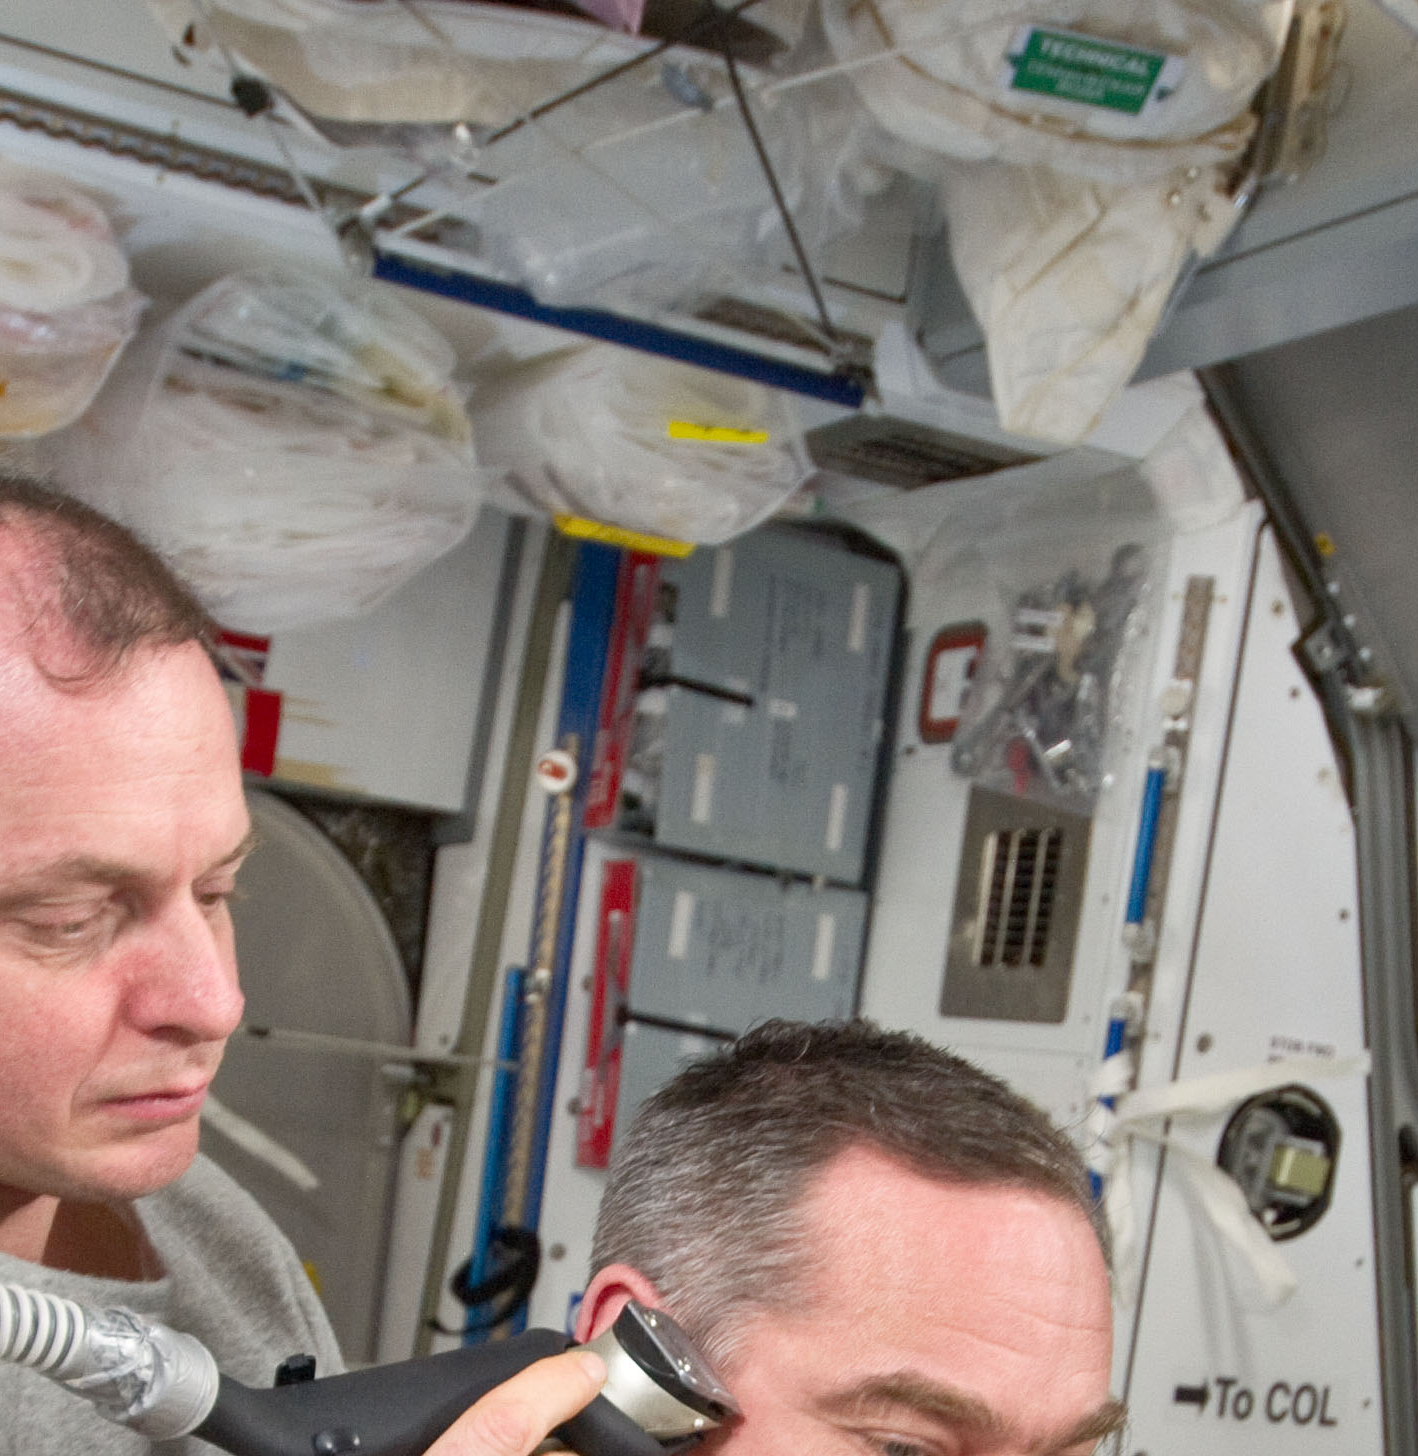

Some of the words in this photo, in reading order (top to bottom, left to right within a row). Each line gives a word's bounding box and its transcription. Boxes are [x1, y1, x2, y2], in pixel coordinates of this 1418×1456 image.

[1040, 37, 1150, 76] TECHNICAL
[1214, 1375, 1255, 1421] To
[1265, 1380, 1338, 1427] COL
